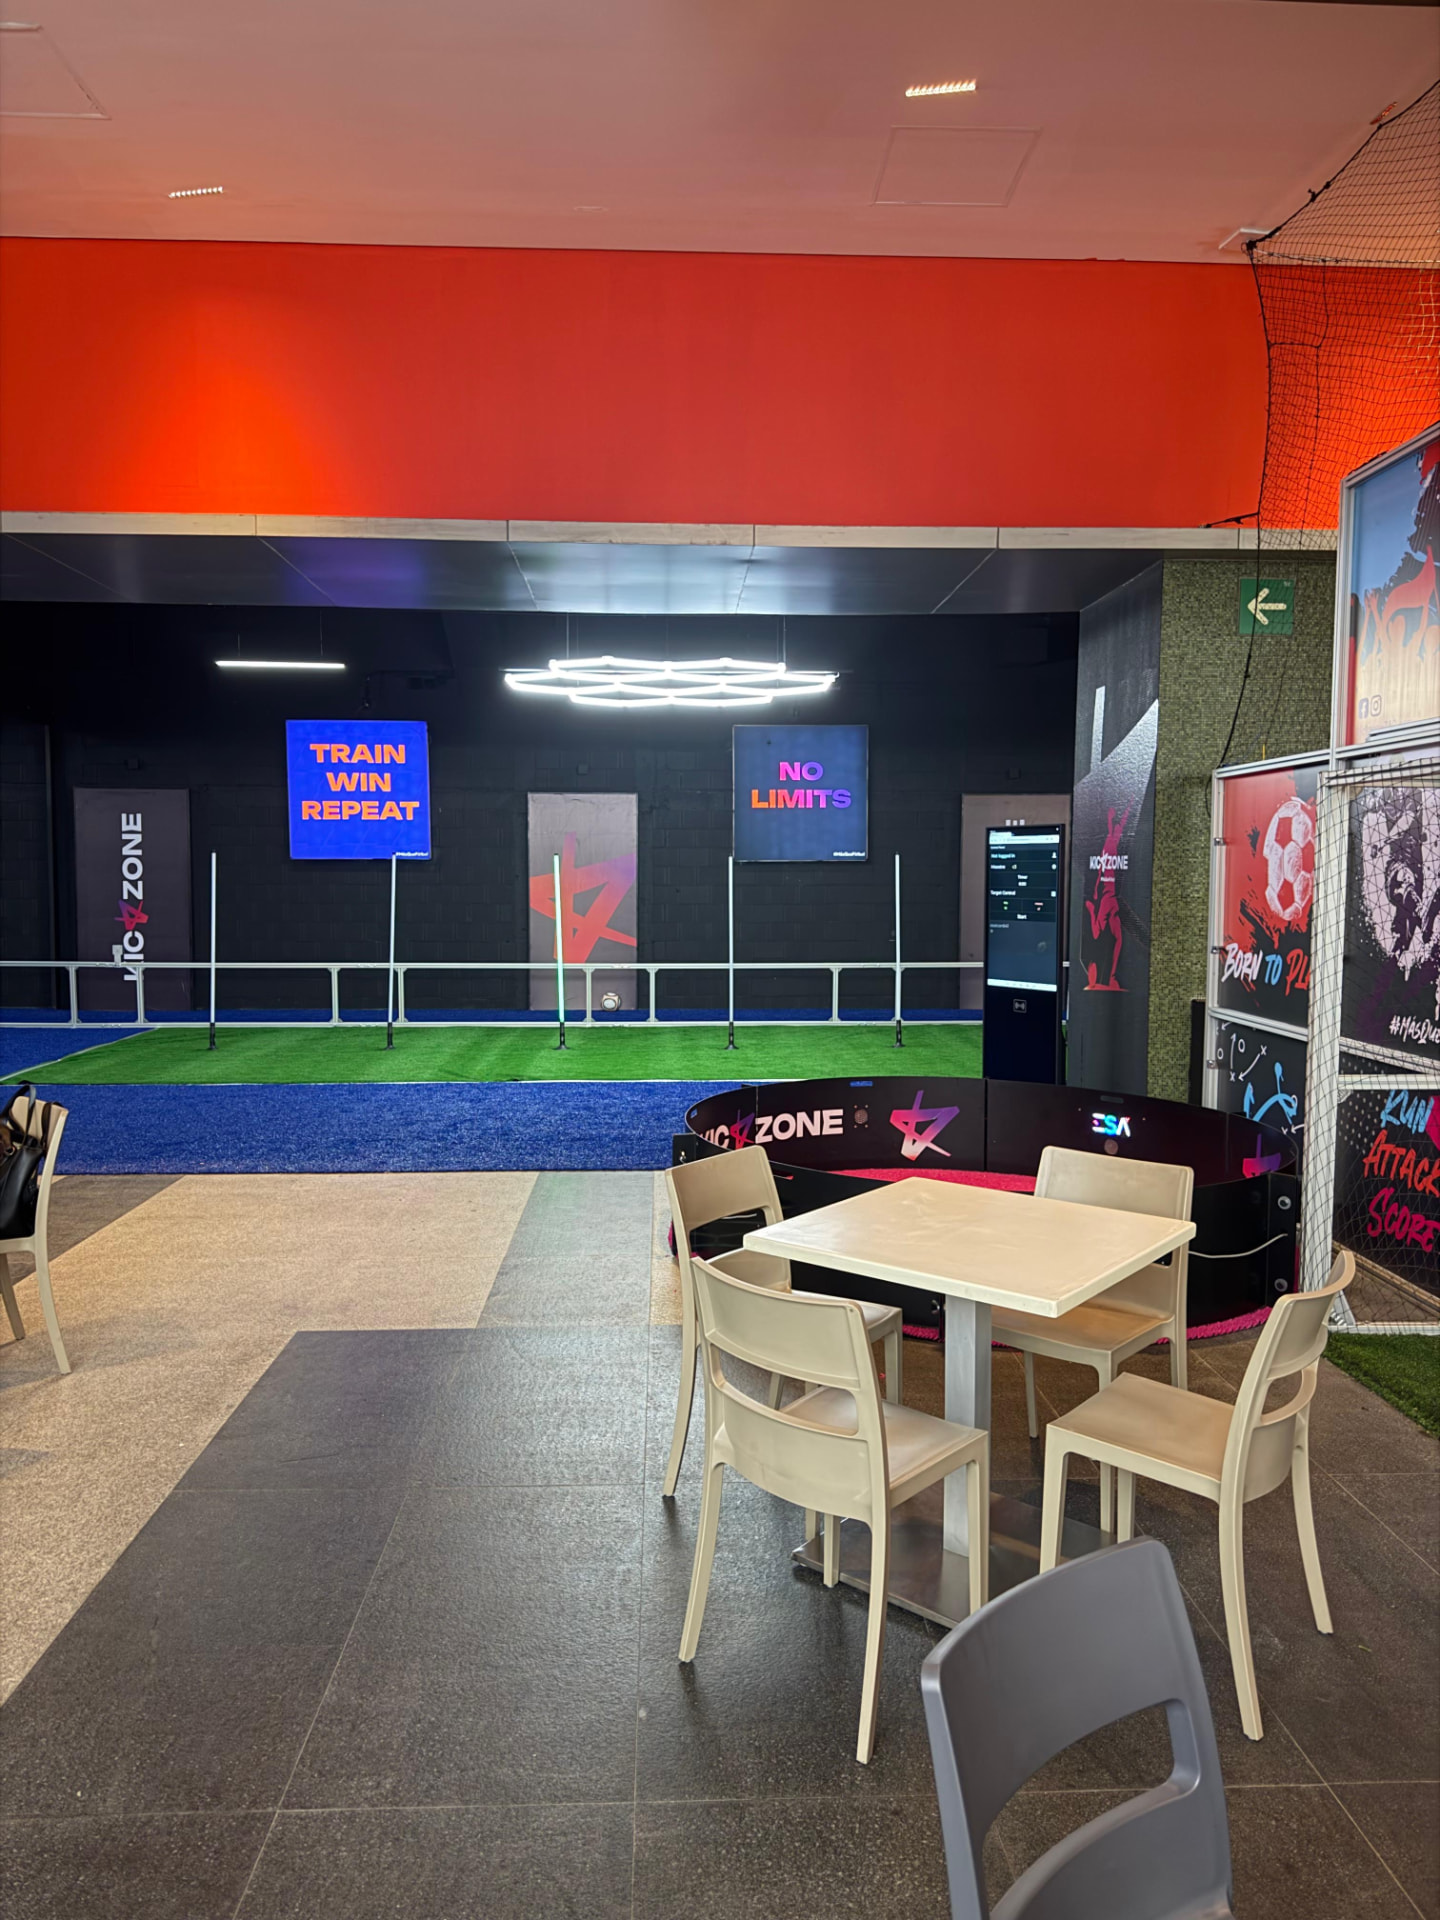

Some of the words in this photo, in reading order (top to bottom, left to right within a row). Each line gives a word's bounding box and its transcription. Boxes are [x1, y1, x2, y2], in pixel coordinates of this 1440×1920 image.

[309, 743, 406, 764] TRAIN
[326, 772, 391, 792] WIN
[779, 761, 824, 781] NO
[301, 800, 420, 820] REPEAT
[751, 789, 852, 808] LIMITS
[1221, 942, 1263, 982] BORN
[1265, 954, 1283, 986] TO
[1285, 948, 1311, 996] PL
[1380, 1089, 1435, 1134] RUN
[1092, 1112, 1131, 1137] ESA
[1363, 1129, 1440, 1198] ATTACK
[1367, 1187, 1440, 1252] SCORE
